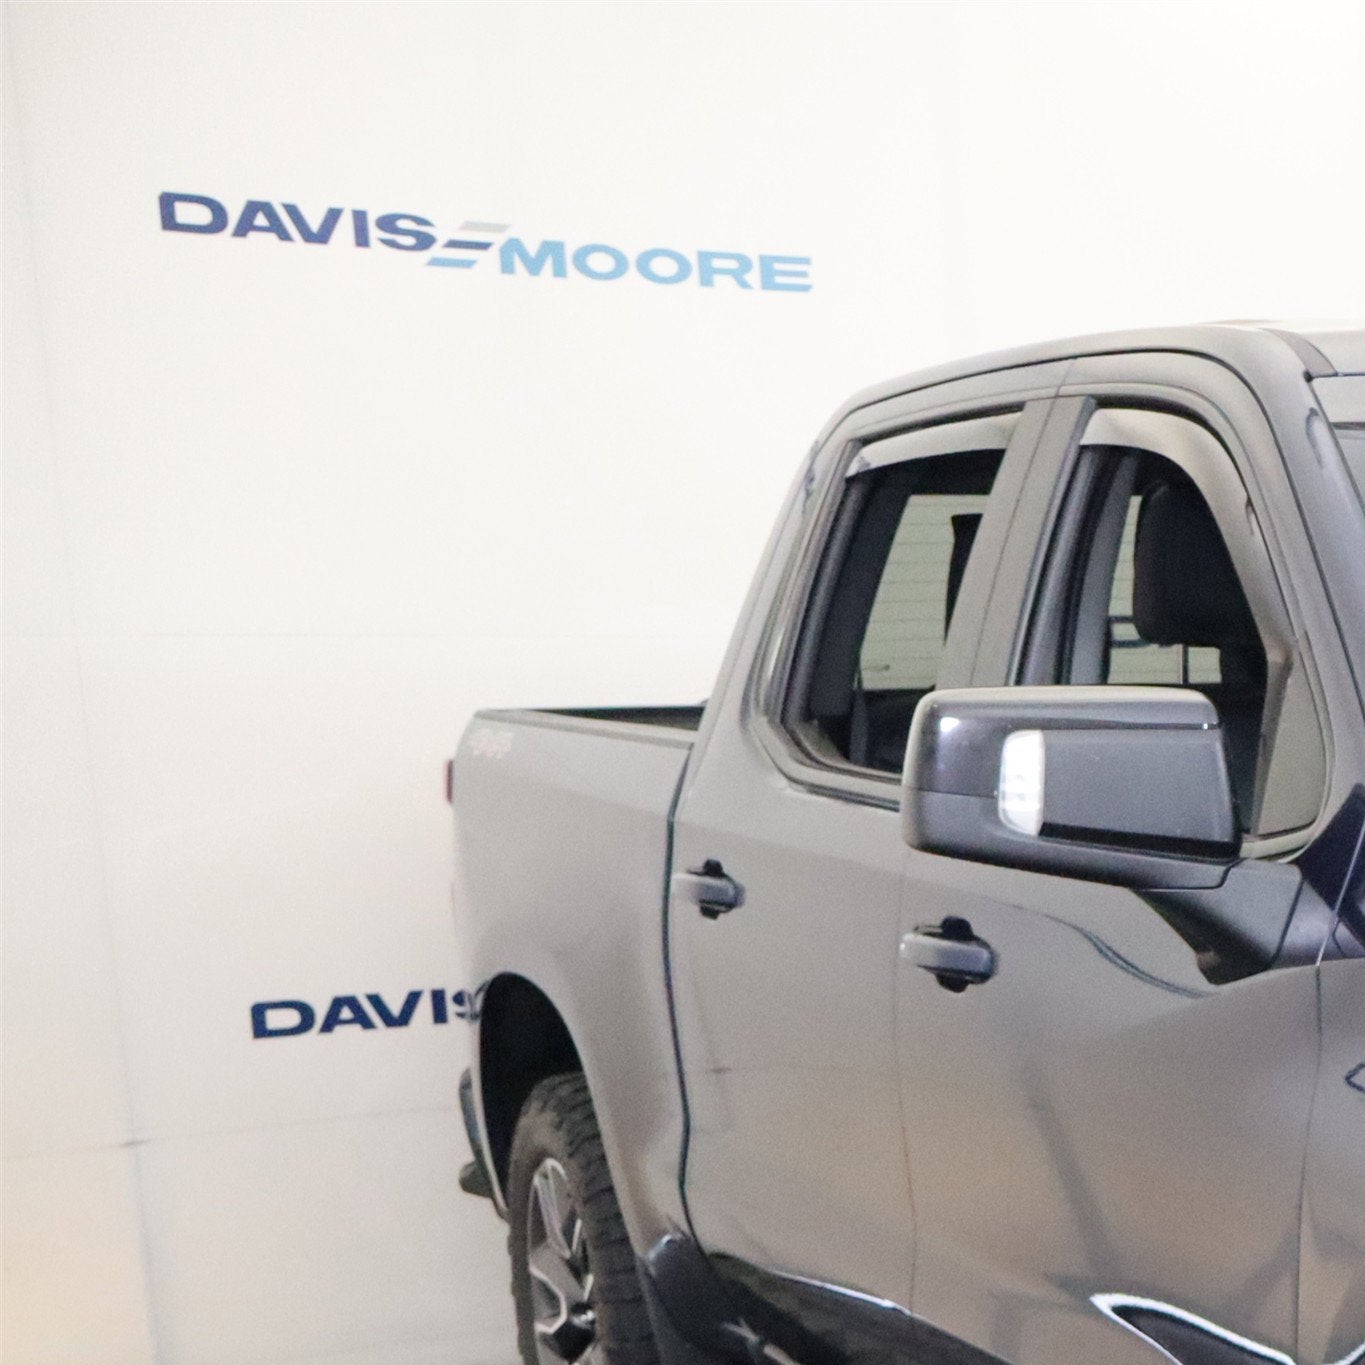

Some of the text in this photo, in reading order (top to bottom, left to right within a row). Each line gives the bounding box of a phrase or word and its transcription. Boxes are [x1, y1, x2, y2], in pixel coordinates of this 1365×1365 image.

[159, 191, 813, 293] DAVIS MOORE
[250, 988, 470, 1039] DAVI
